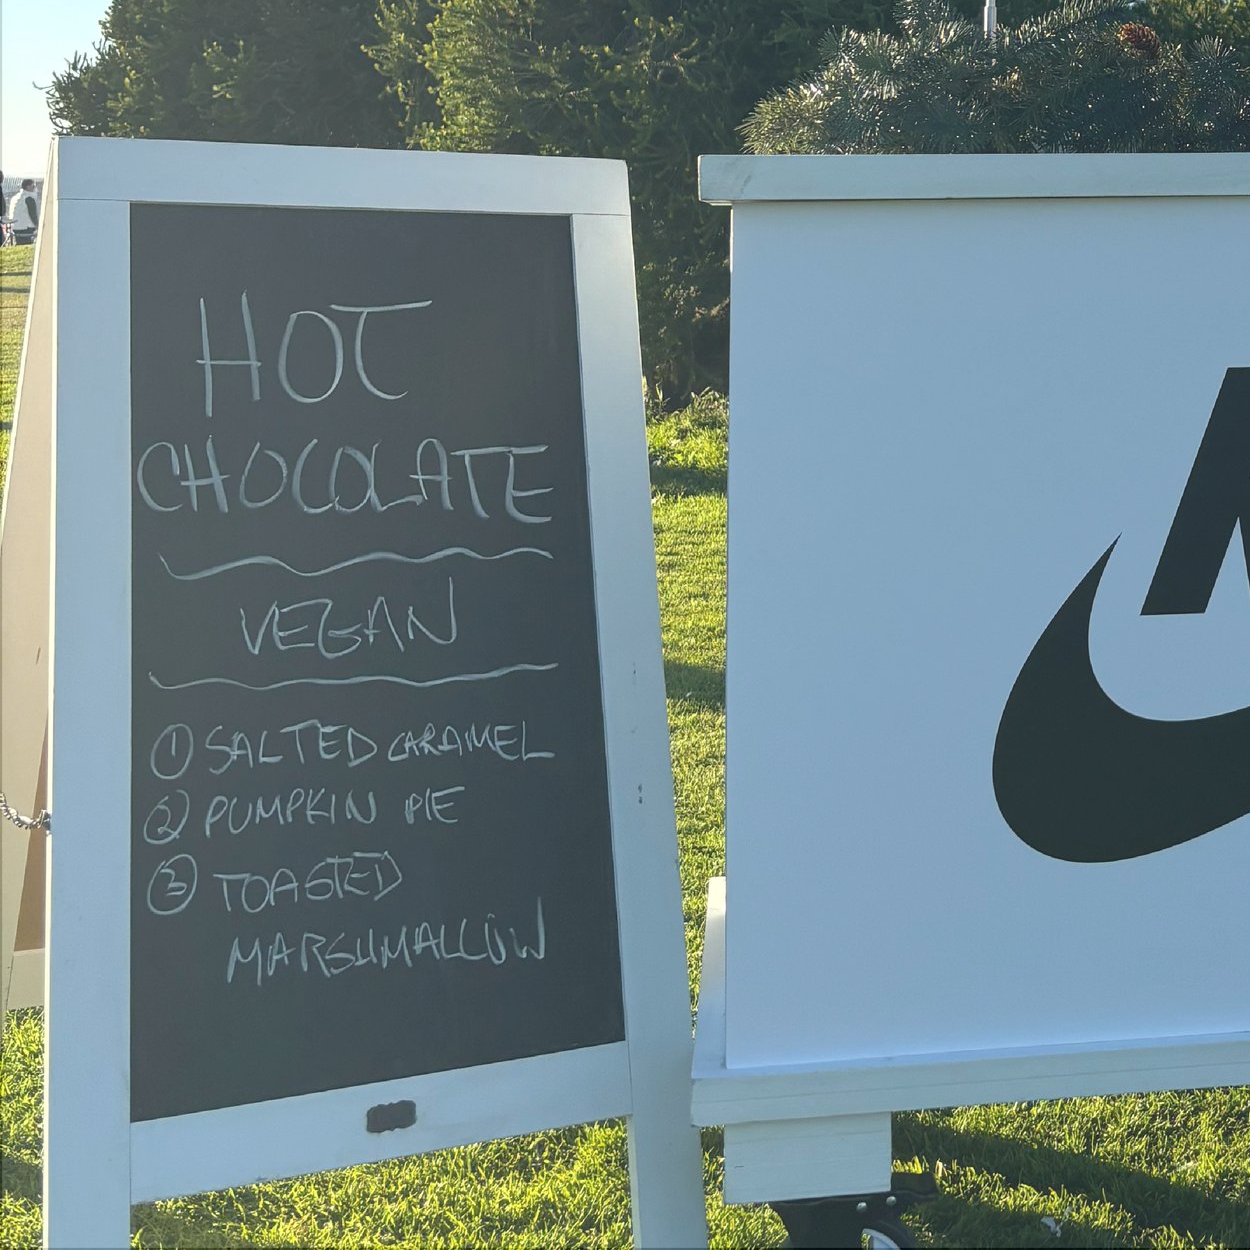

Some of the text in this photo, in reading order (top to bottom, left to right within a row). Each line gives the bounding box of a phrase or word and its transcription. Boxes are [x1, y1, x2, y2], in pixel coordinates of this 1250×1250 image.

[196, 290, 432, 417] HOT
[136, 435, 554, 523] CHOCOLATE
[239, 576, 457, 659] VEGAN
[205, 719, 378, 774] SALTED
[388, 720, 555, 762] CARAMEL
[205, 787, 377, 838] PUMPKIN
[405, 786, 465, 824] PIE
[213, 851, 402, 913] TOASTED
[227, 896, 546, 986] MARSHMALLOW
